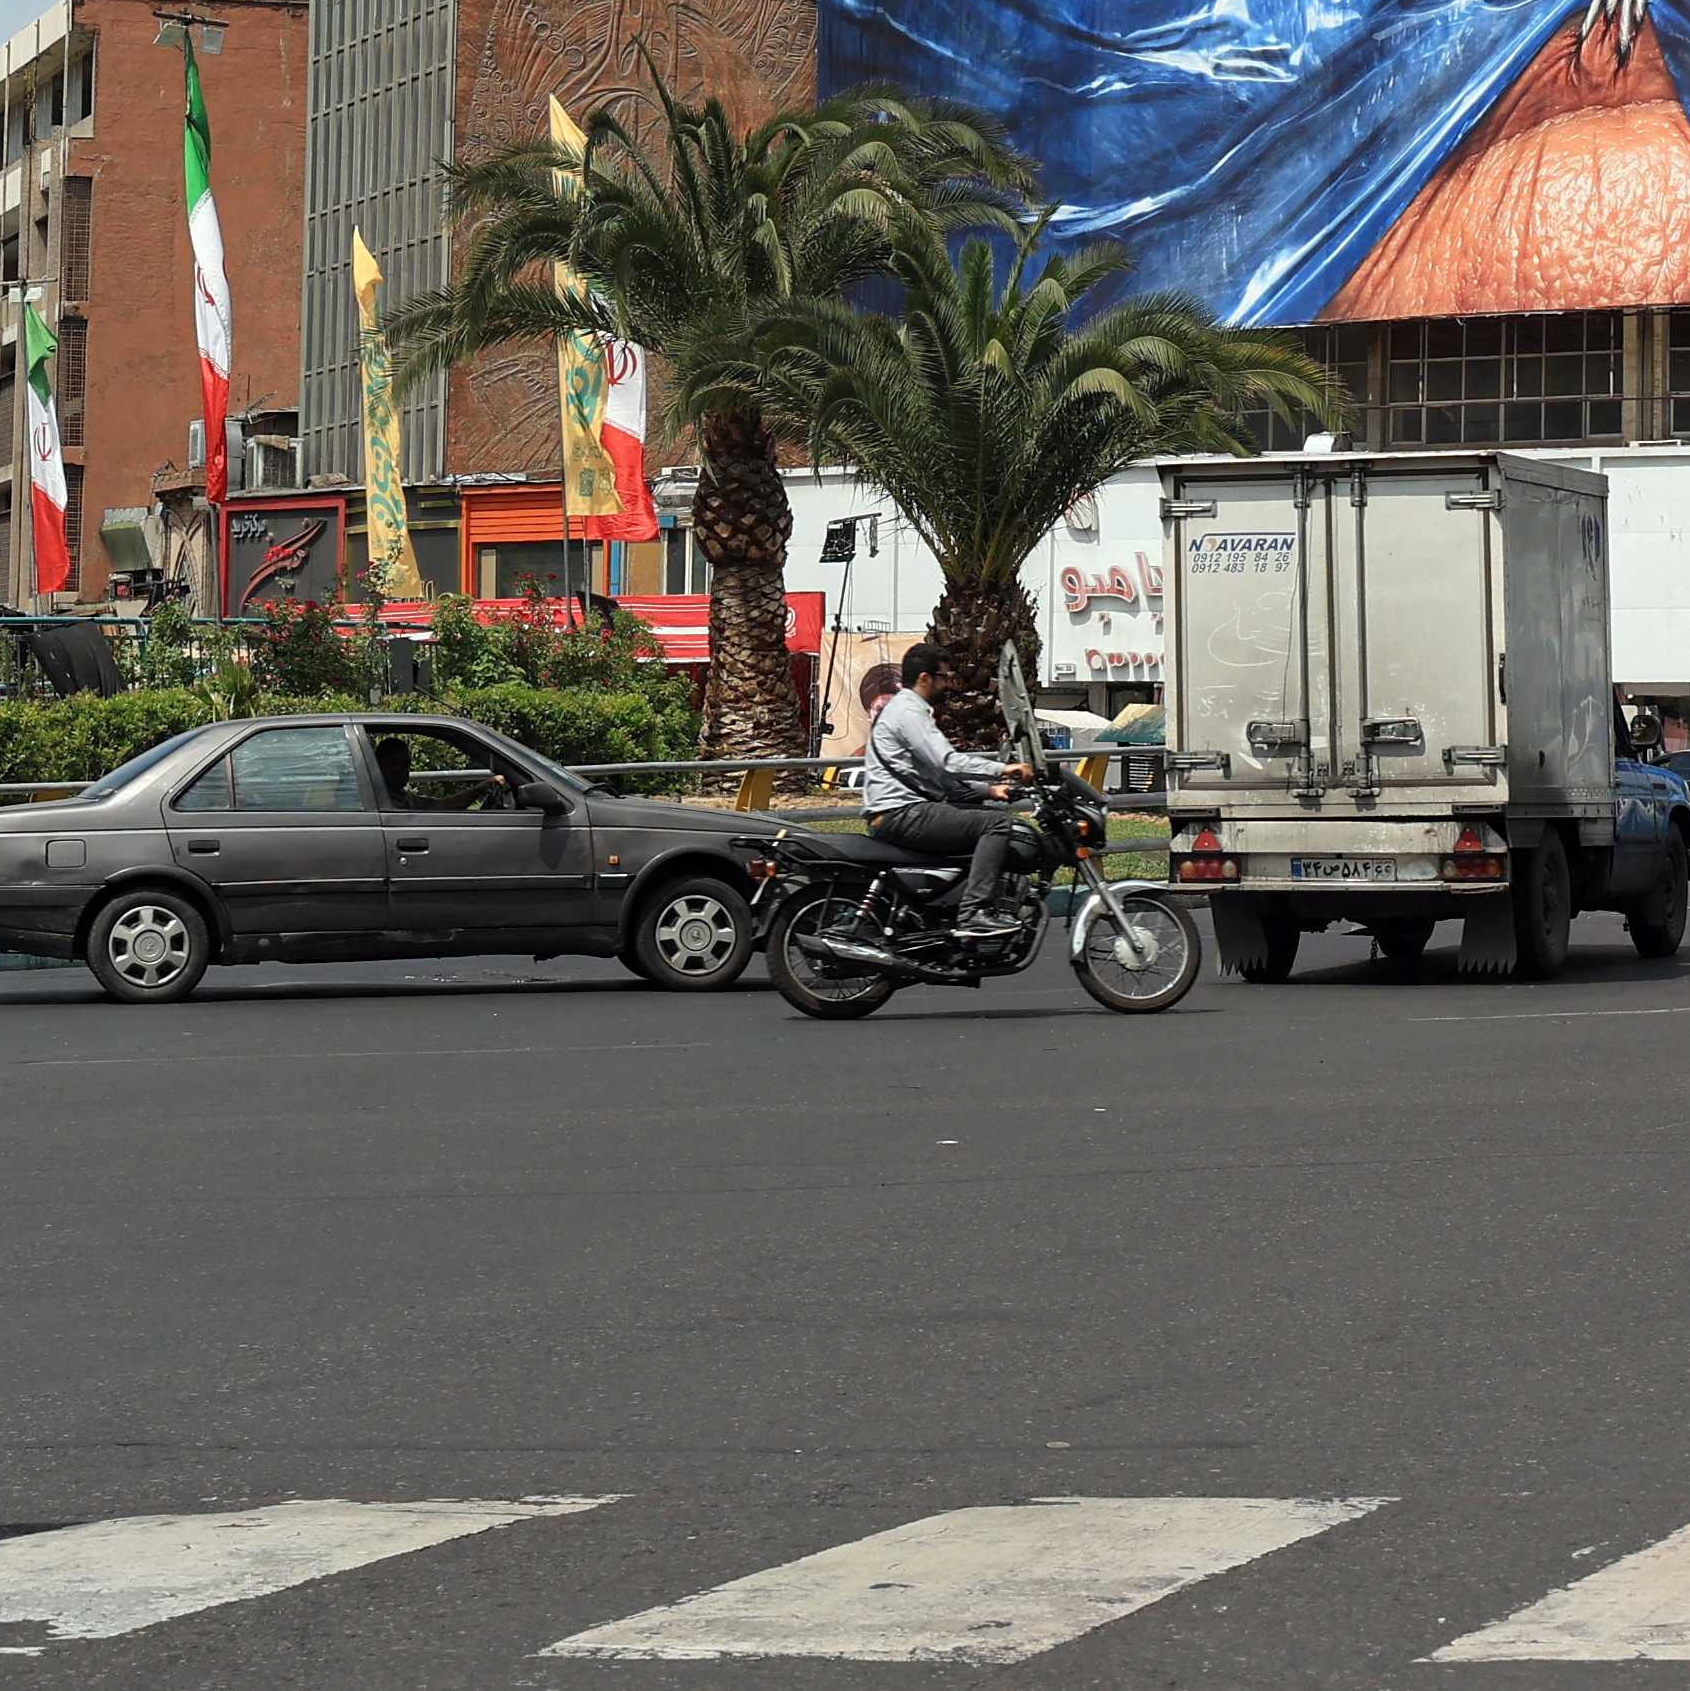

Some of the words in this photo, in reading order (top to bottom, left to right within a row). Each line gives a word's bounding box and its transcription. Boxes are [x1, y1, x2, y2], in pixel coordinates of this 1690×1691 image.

[1193, 552, 1222, 563] 0912
[1226, 552, 1247, 563] 195
[1191, 563, 1221, 573] 0912
